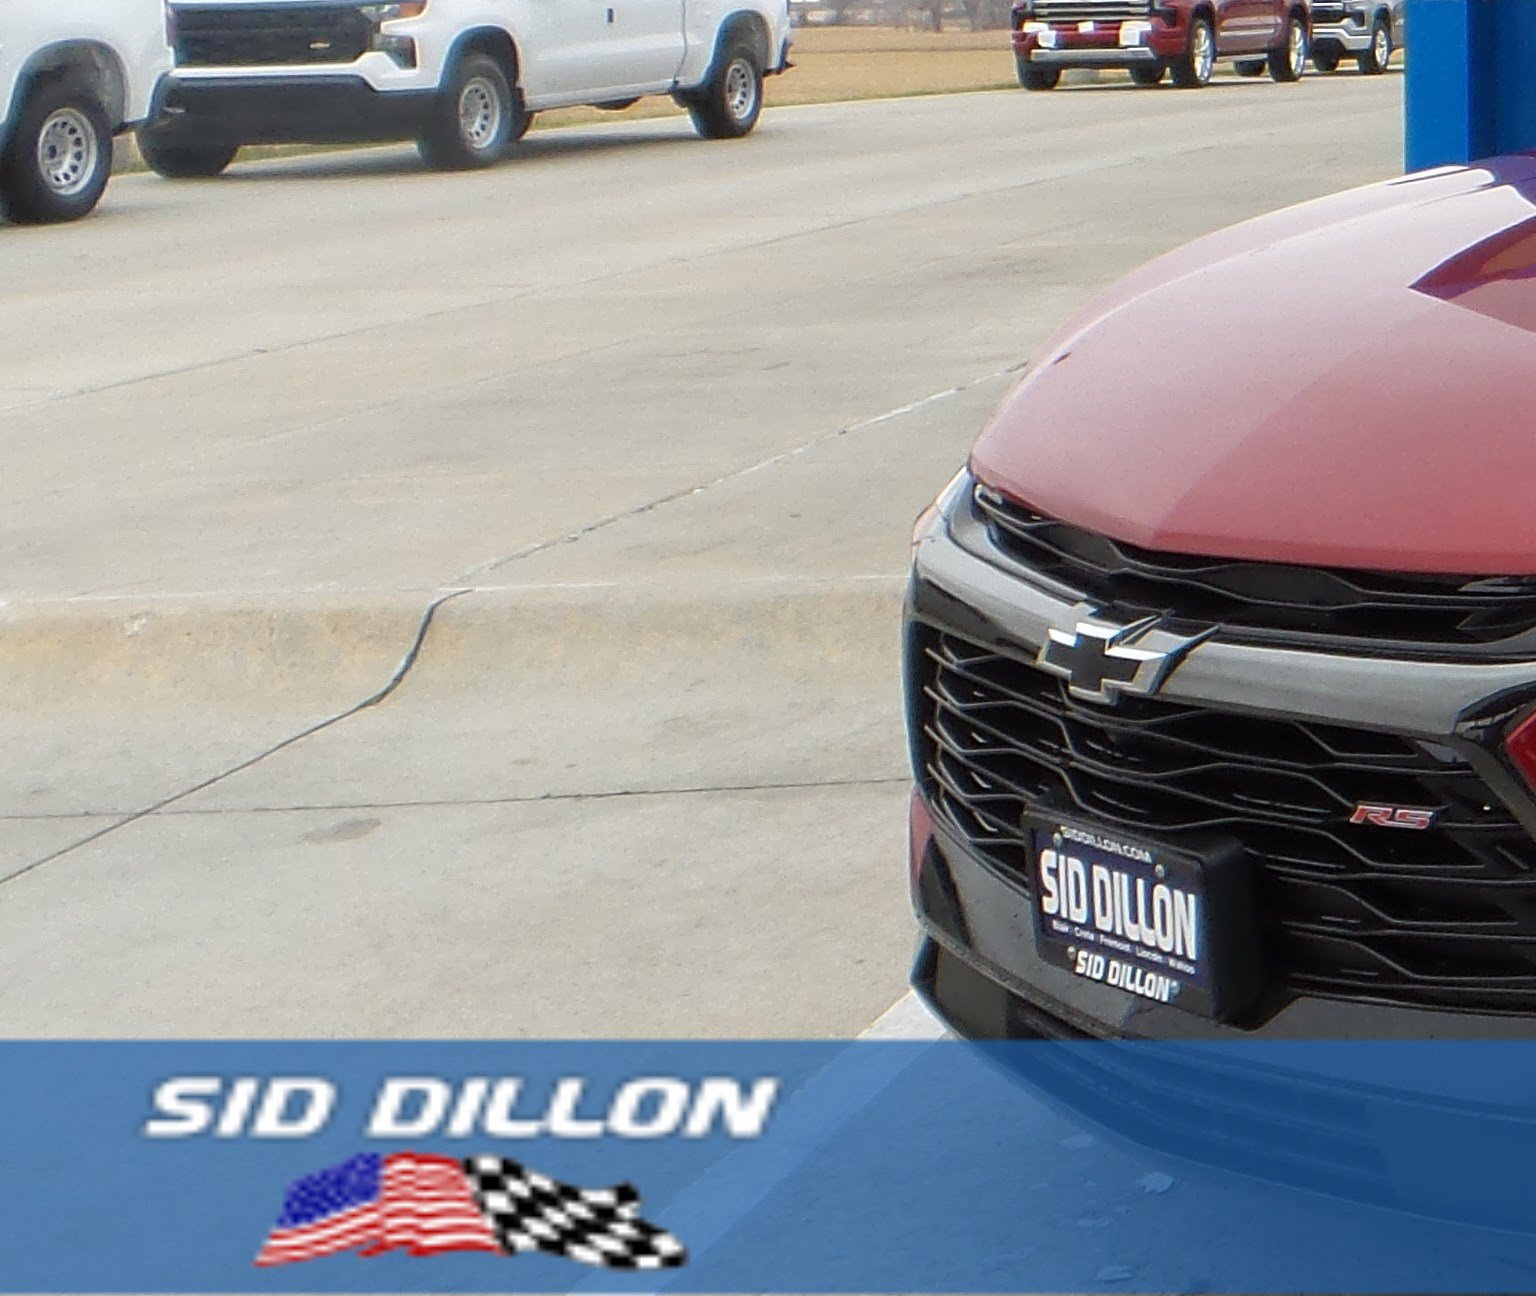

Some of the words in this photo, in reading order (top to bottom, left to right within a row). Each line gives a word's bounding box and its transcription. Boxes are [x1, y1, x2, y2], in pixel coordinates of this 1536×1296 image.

[1348, 804, 1434, 830] RS
[1040, 848, 1088, 925] SID
[1092, 863, 1199, 961] DILLON
[1074, 949, 1106, 981] SID
[1106, 959, 1171, 1002] DILLON
